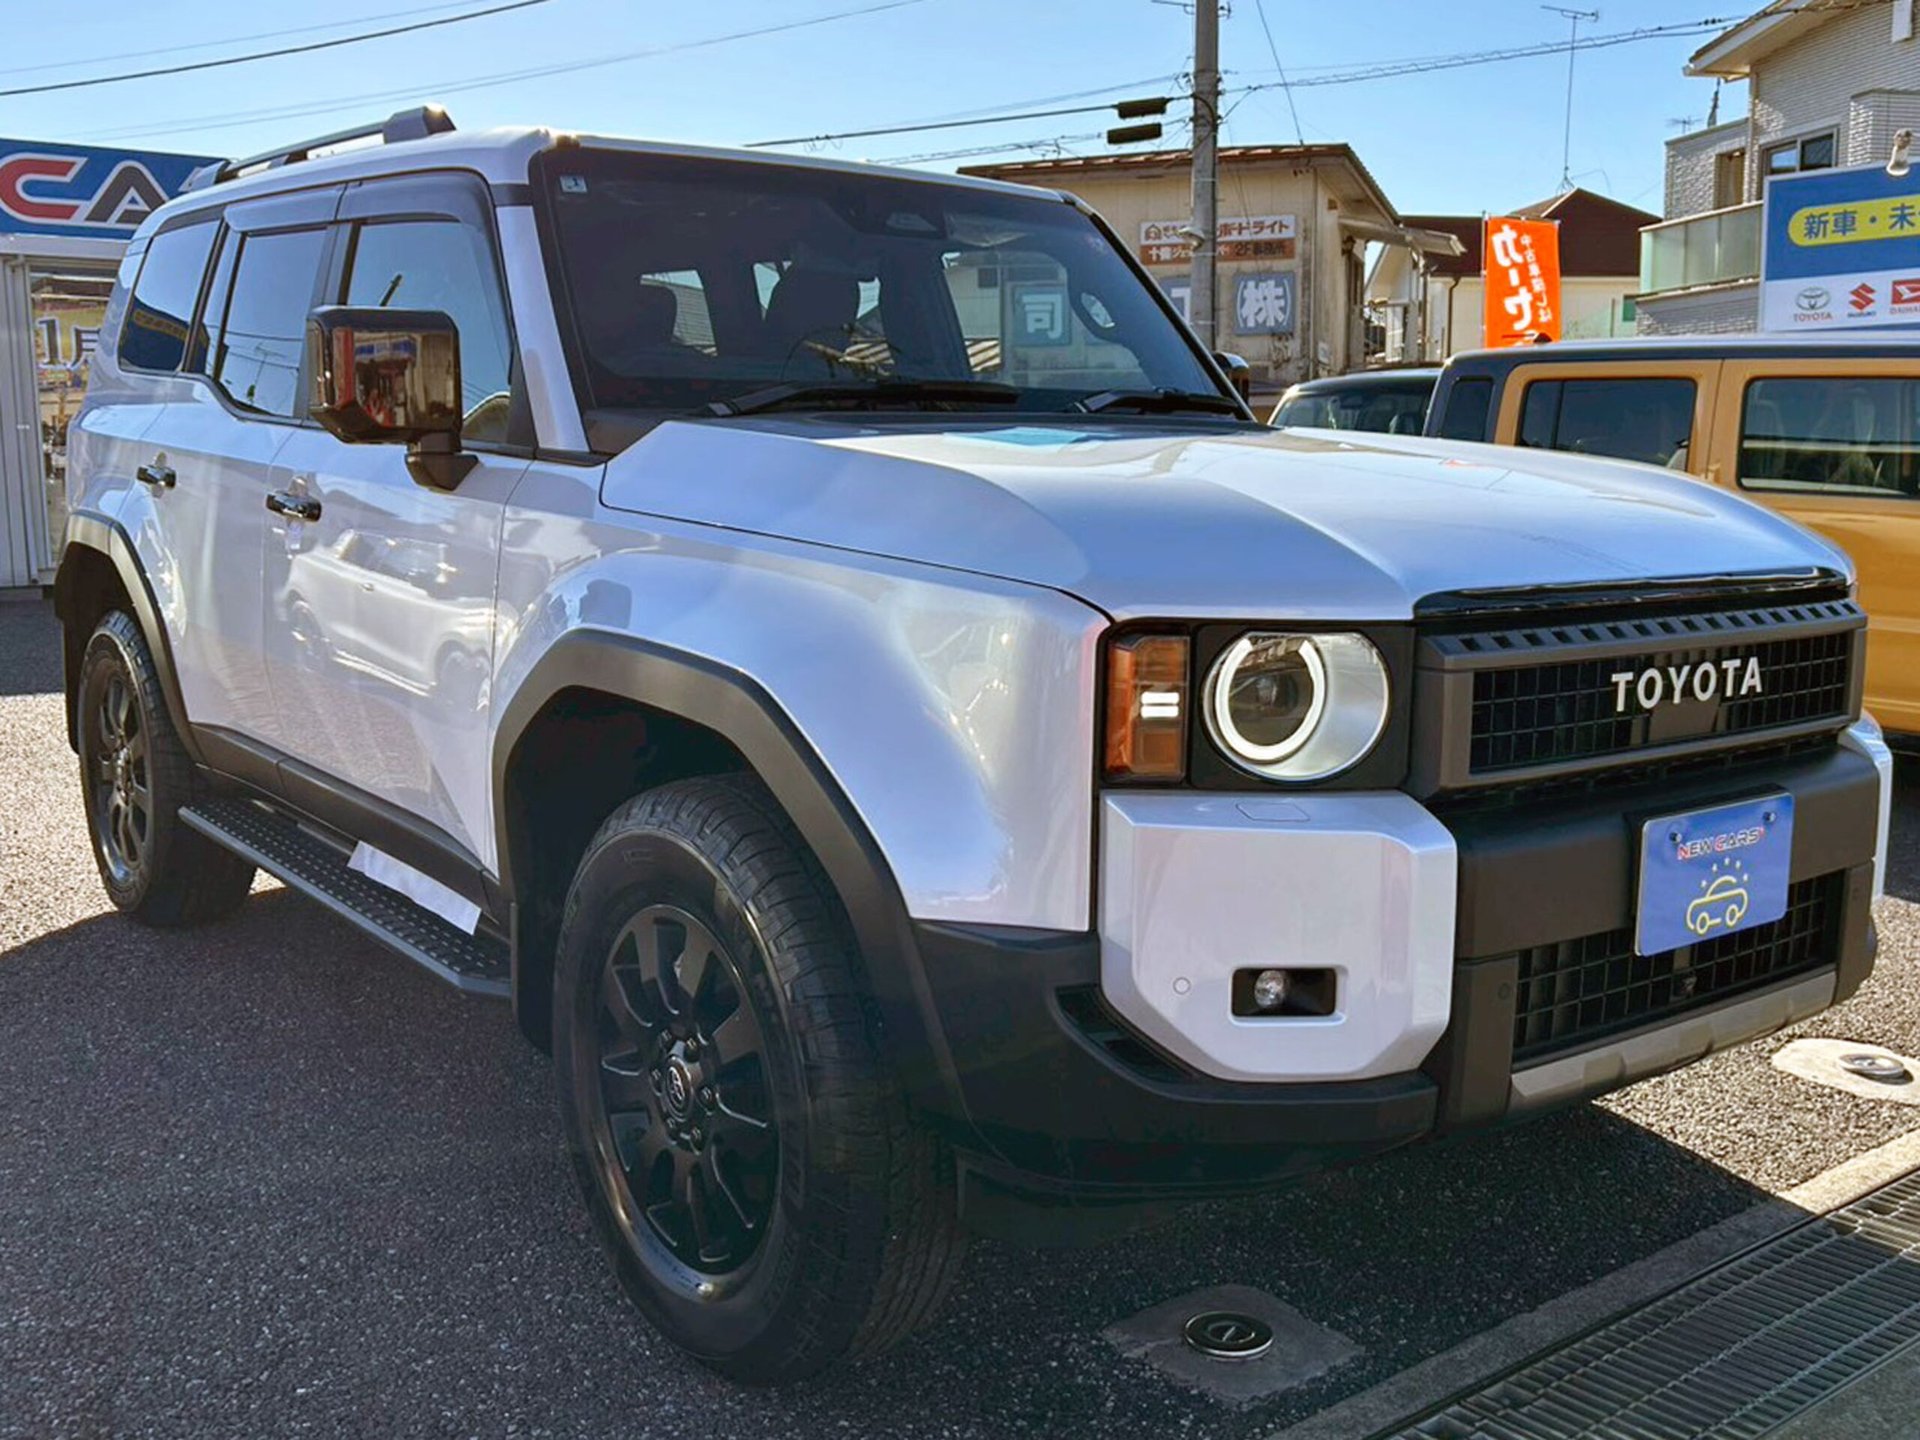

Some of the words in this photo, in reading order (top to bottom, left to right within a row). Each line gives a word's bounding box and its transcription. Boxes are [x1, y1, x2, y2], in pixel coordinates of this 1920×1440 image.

[1804, 203, 1920, 239] 新車・未
[1793, 311, 1833, 322] TOYOTA
[1611, 656, 1763, 713] TOYOTA
[1677, 836, 1713, 861] NEW
